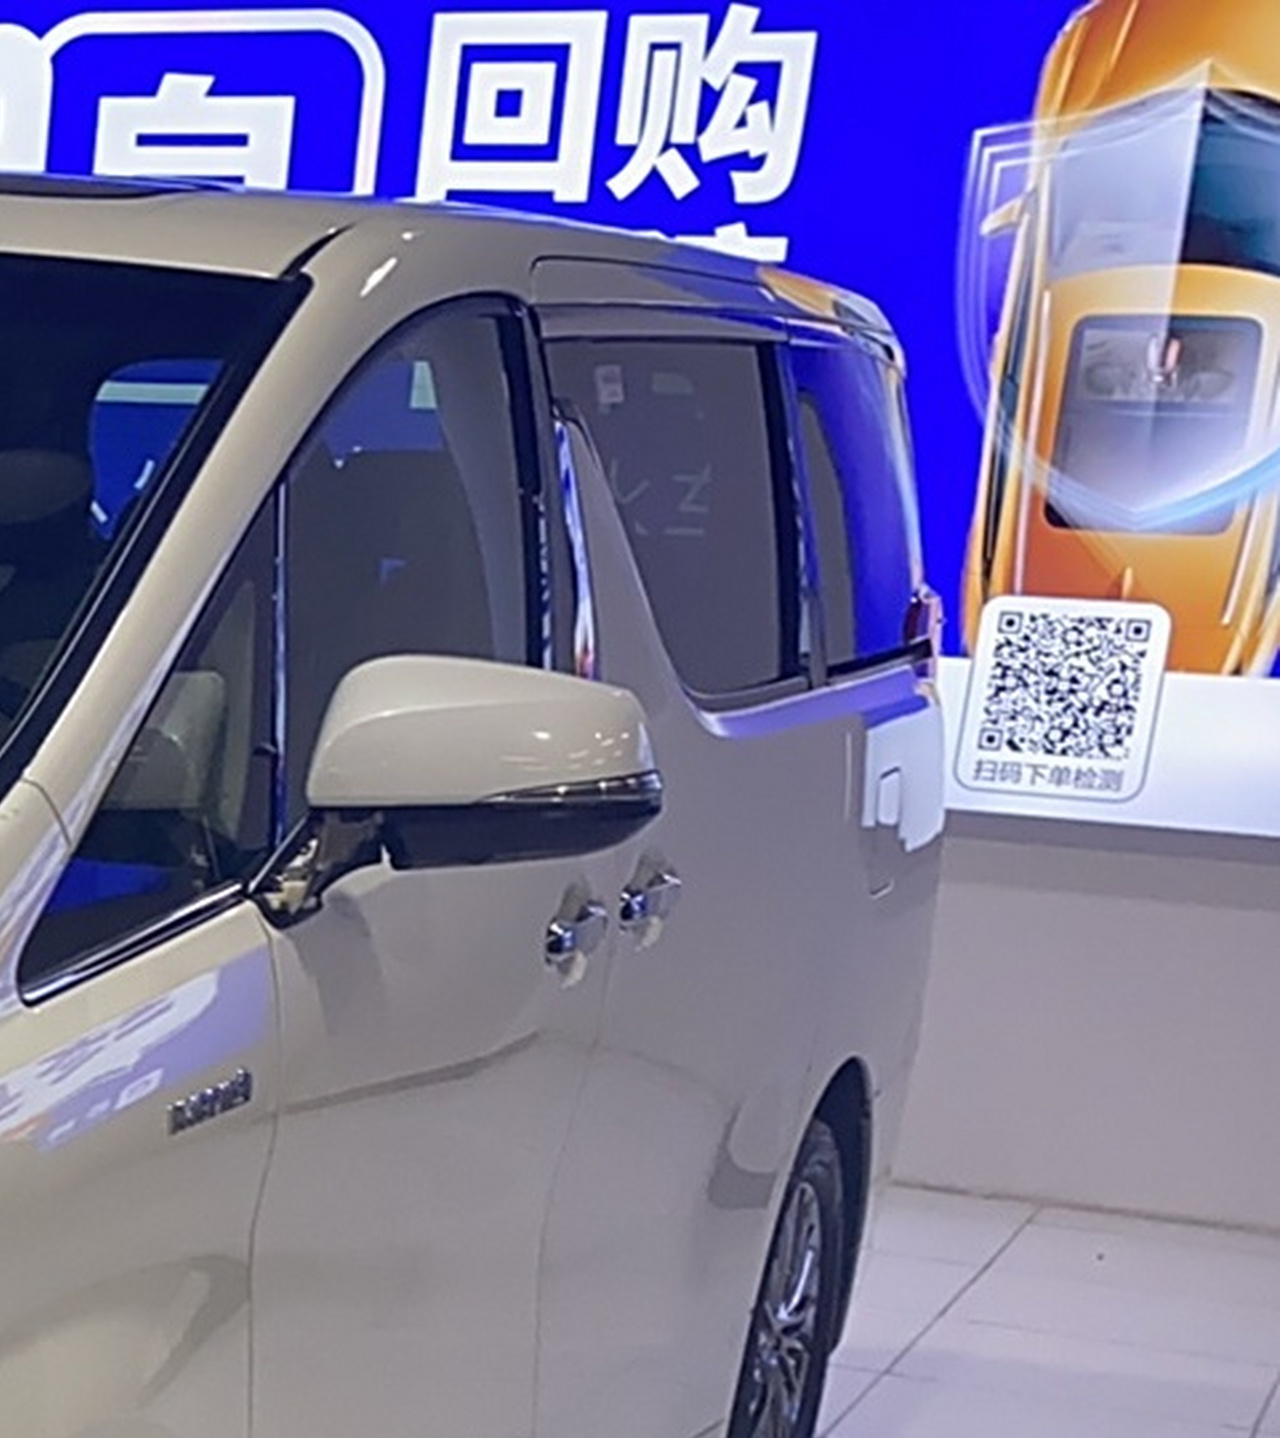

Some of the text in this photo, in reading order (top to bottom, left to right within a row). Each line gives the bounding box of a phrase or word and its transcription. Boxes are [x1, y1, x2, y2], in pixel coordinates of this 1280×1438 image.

[415, 3, 818, 204] 回购
[973, 758, 1125, 793] 扫码下单检测
